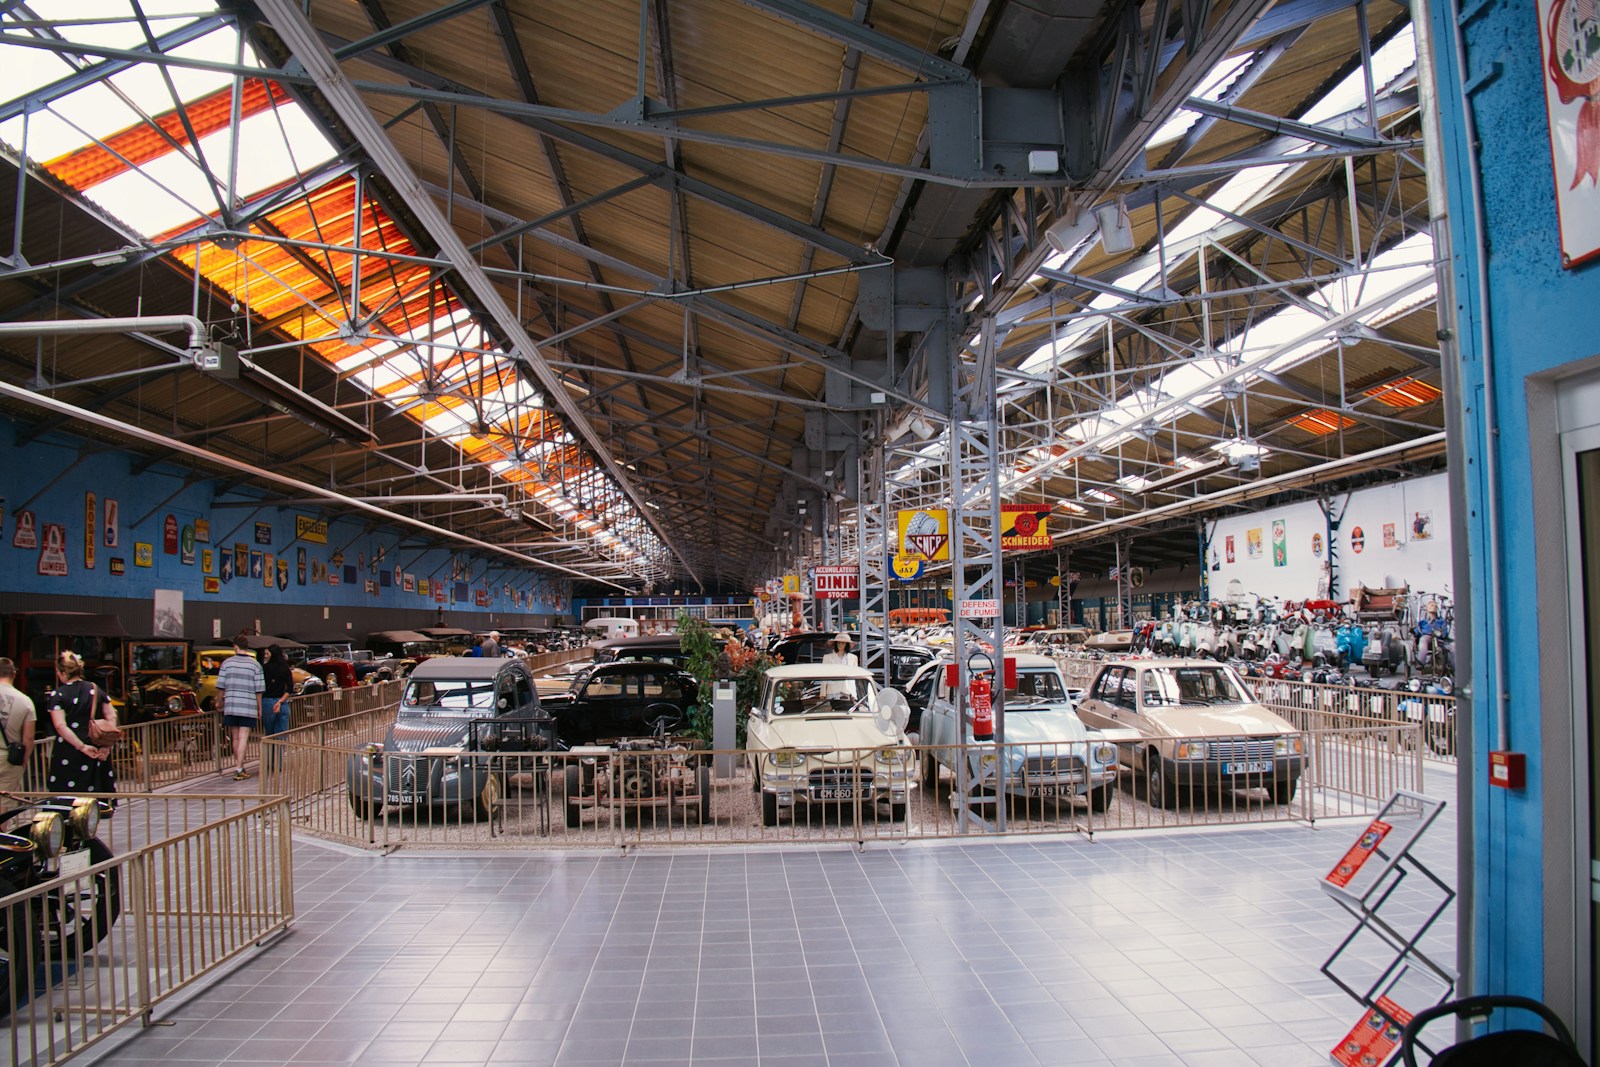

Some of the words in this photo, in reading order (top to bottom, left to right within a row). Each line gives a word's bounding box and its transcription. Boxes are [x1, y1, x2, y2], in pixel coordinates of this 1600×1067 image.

[1026, 504, 1049, 512] SERVICE
[1002, 537, 1050, 546] SCHNEIDER
[817, 576, 858, 589] DININ
[974, 608, 1000, 616] FUMER
